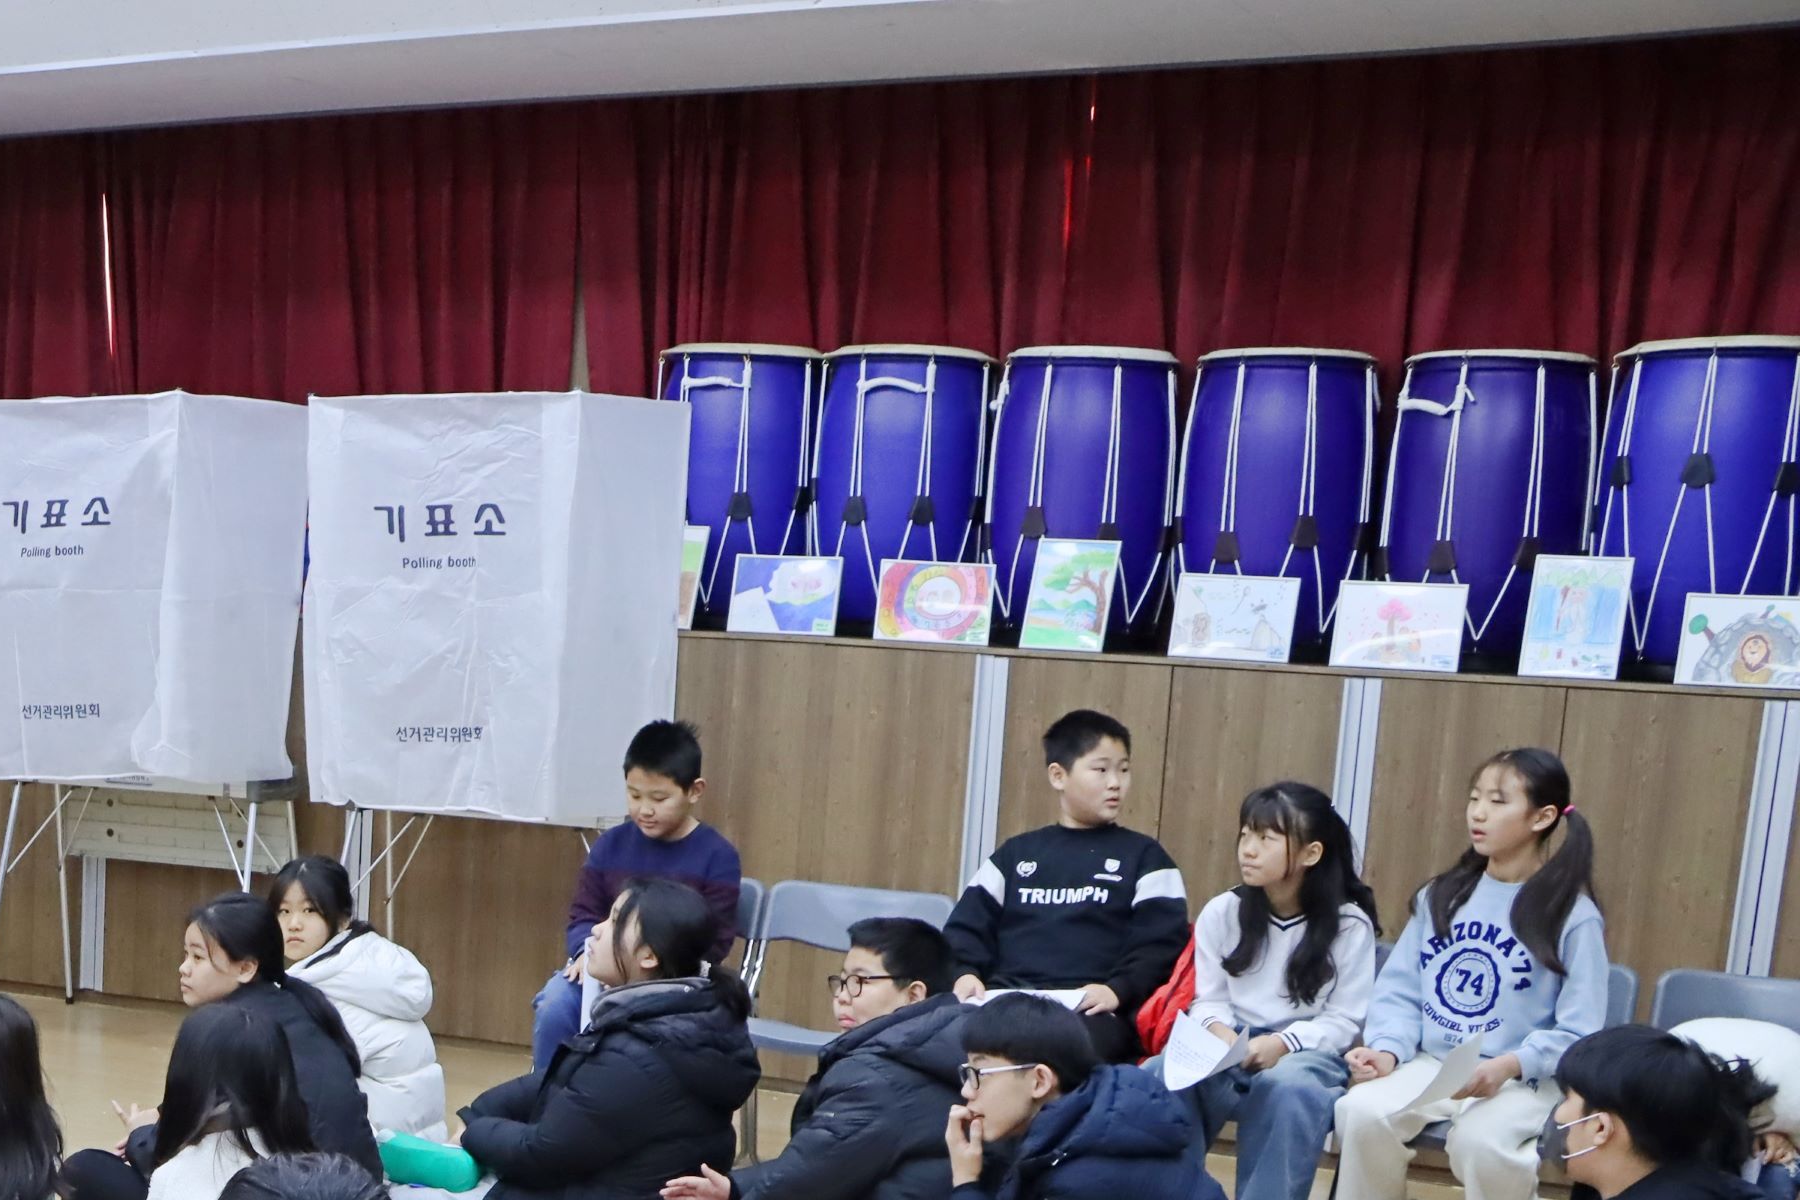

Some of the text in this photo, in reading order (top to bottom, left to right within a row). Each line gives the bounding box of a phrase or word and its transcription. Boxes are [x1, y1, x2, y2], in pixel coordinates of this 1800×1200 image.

[2, 496, 111, 534] 기표소
[373, 503, 507, 543] 기표소
[20, 544, 84, 559] Polling booth
[402, 555, 477, 570] Polling booth
[21, 702, 101, 720] 선거관리위원회
[1018, 886, 1109, 904] TRIUMPH
